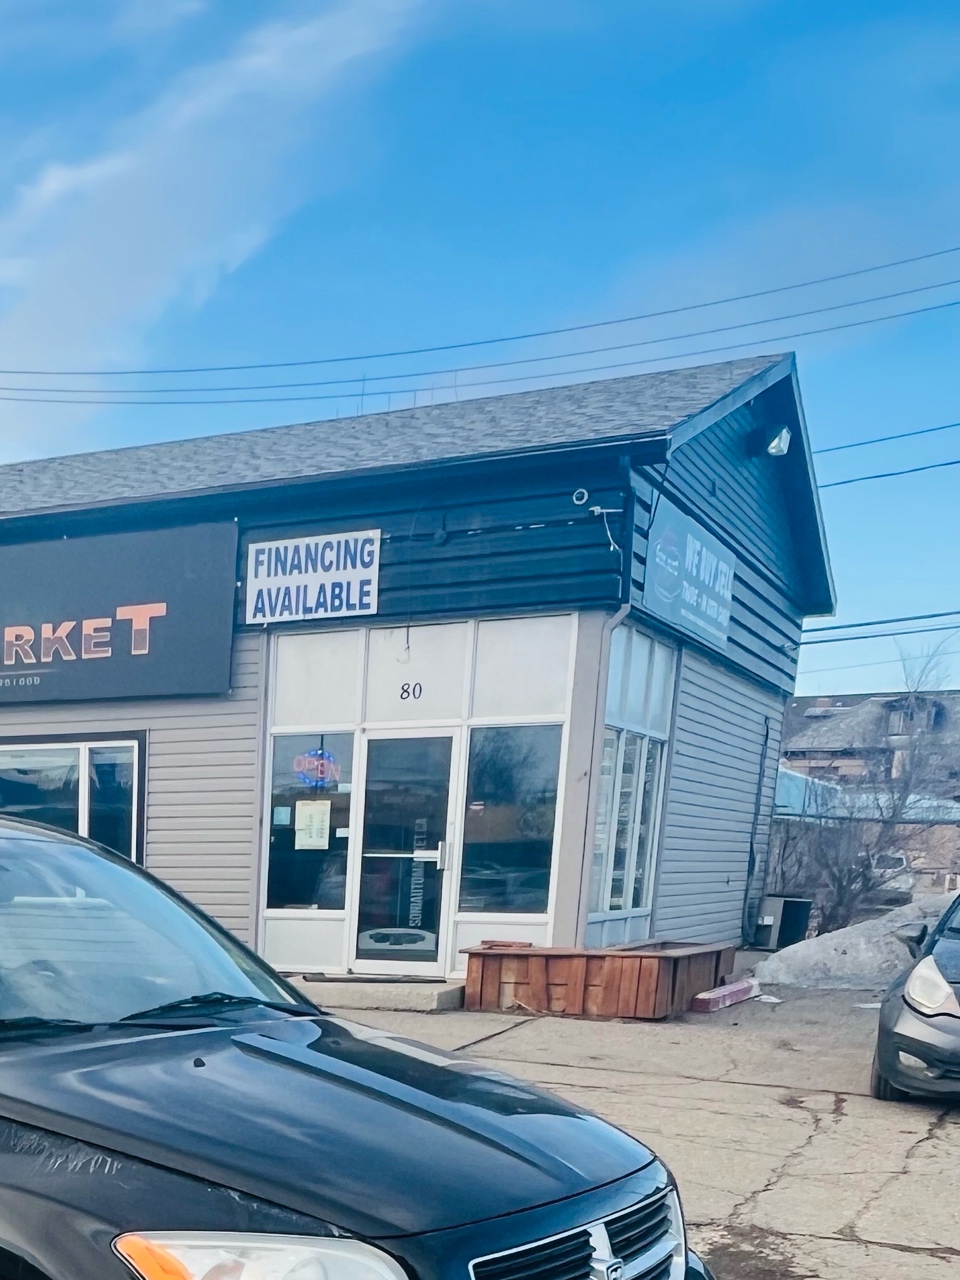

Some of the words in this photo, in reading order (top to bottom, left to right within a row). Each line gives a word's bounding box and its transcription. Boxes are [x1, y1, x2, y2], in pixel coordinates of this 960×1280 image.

[254, 538, 375, 579] FINANCING
[252, 579, 372, 619] AVAILABLE
[400, 682, 422, 700] 80
